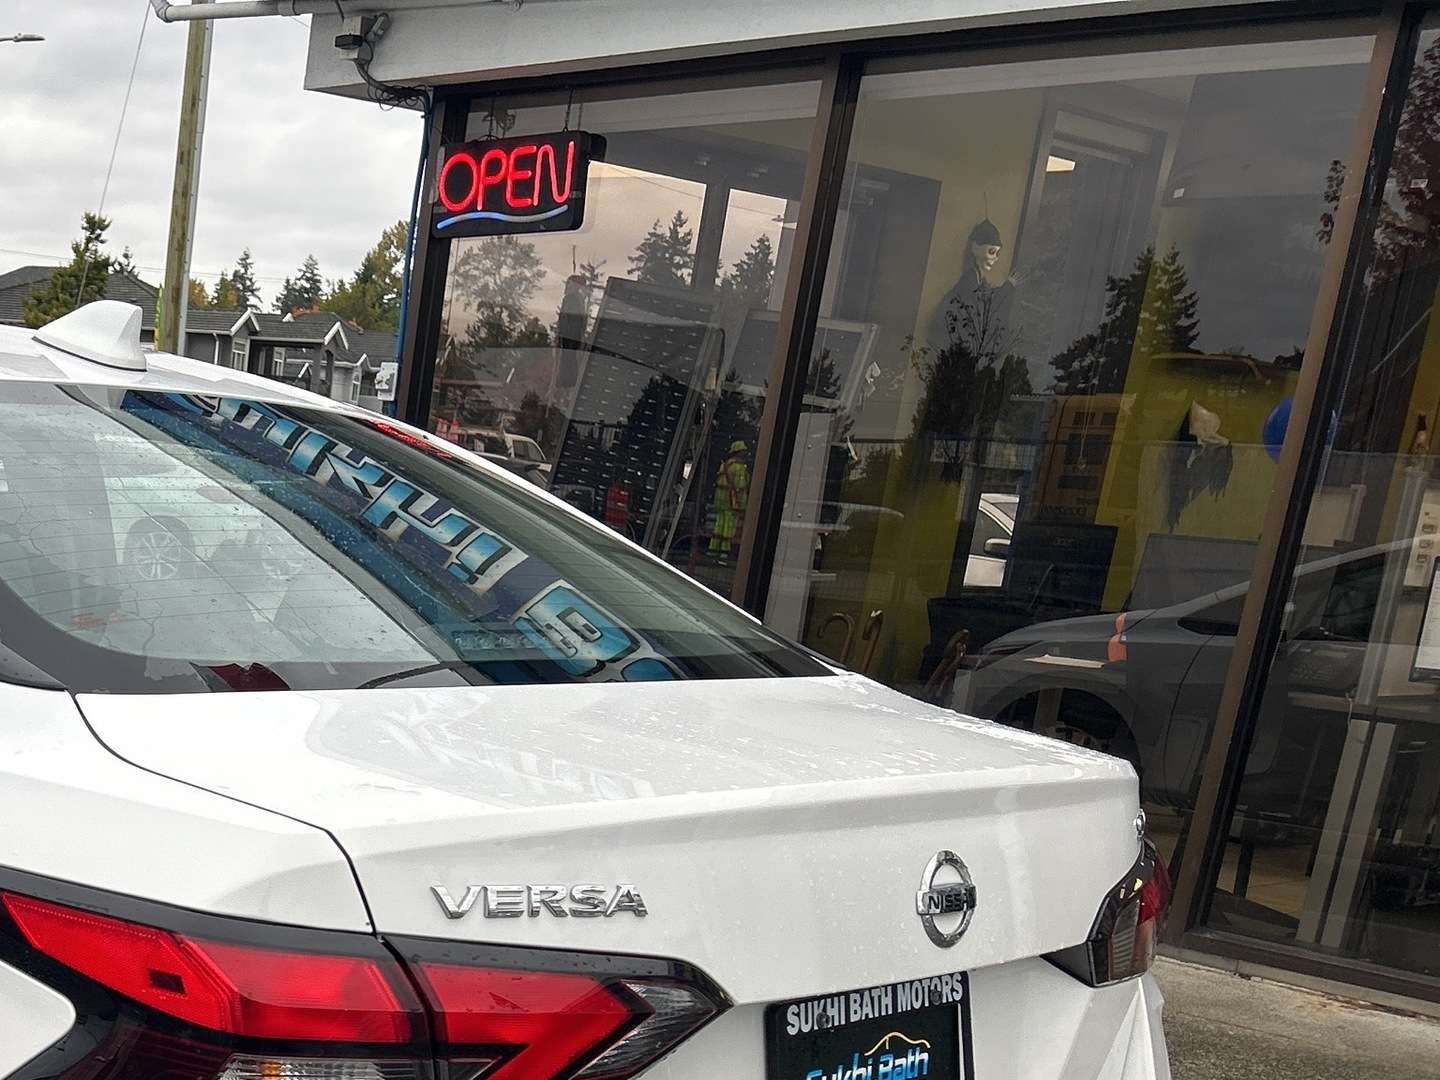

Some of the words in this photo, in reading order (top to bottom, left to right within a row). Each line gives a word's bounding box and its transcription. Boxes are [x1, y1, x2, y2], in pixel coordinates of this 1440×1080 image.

[438, 140, 575, 213] OPEN
[429, 883, 649, 919] VERSA
[786, 995, 846, 1035] SUKHI
[849, 985, 893, 1023] BATH
